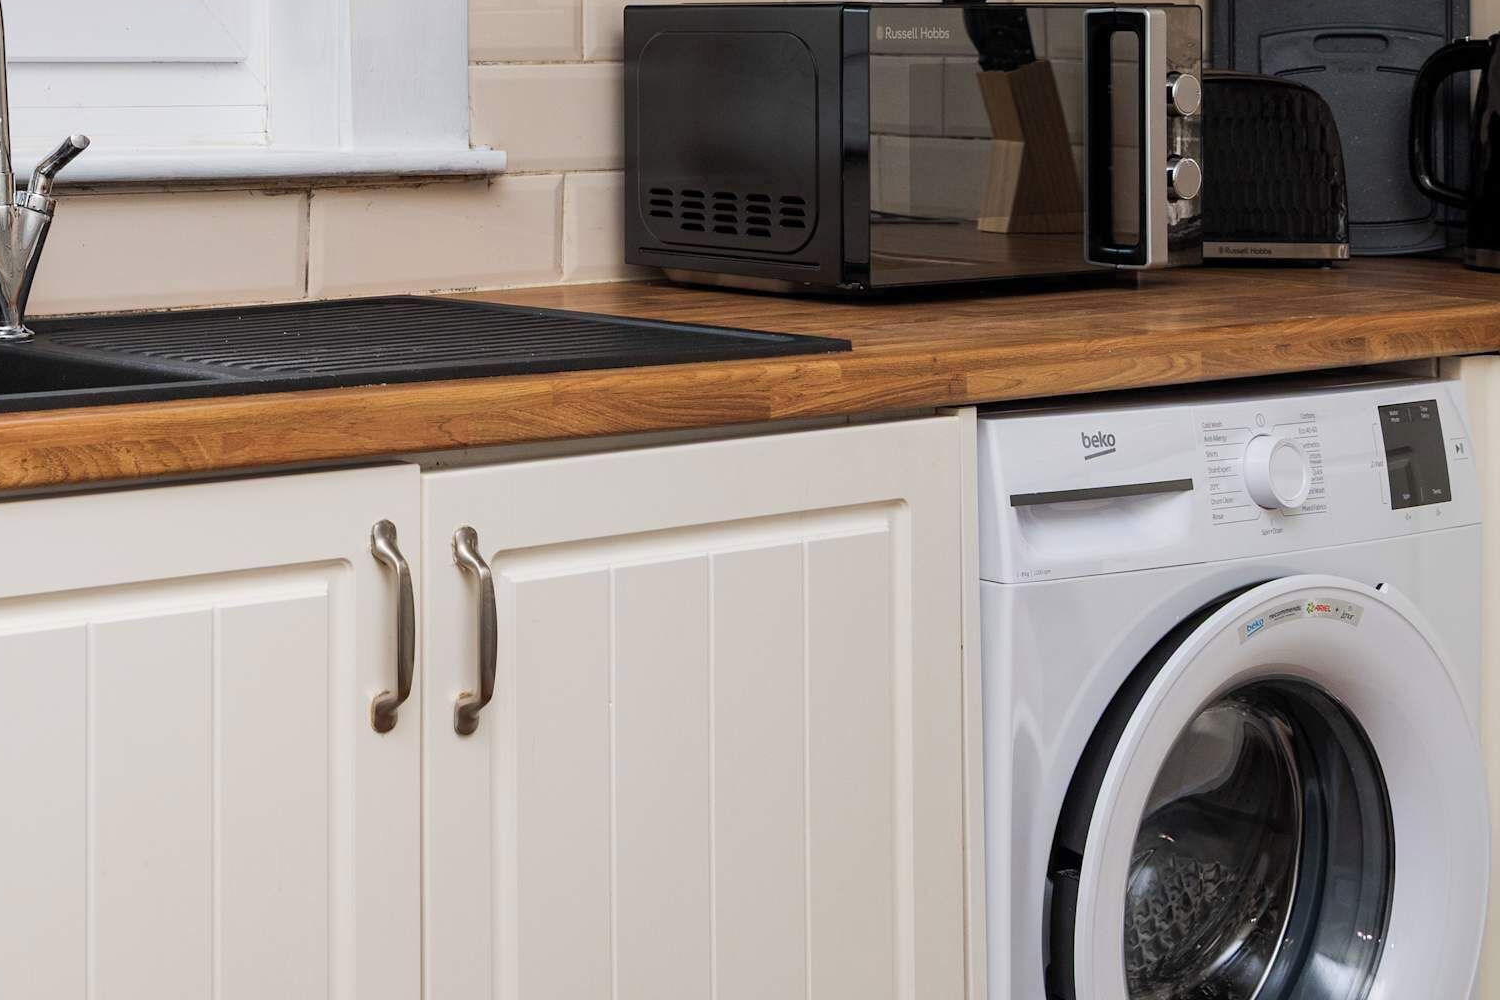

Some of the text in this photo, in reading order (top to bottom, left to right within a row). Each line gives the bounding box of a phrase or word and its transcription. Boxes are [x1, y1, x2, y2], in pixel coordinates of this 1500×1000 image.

[885, 26, 950, 39] Russell Hobbs
[1225, 246, 1272, 255] Russell Hobbs
[1081, 431, 1116, 448] beko
[1246, 618, 1264, 633] beko
[1315, 604, 1332, 613] ARIEL
